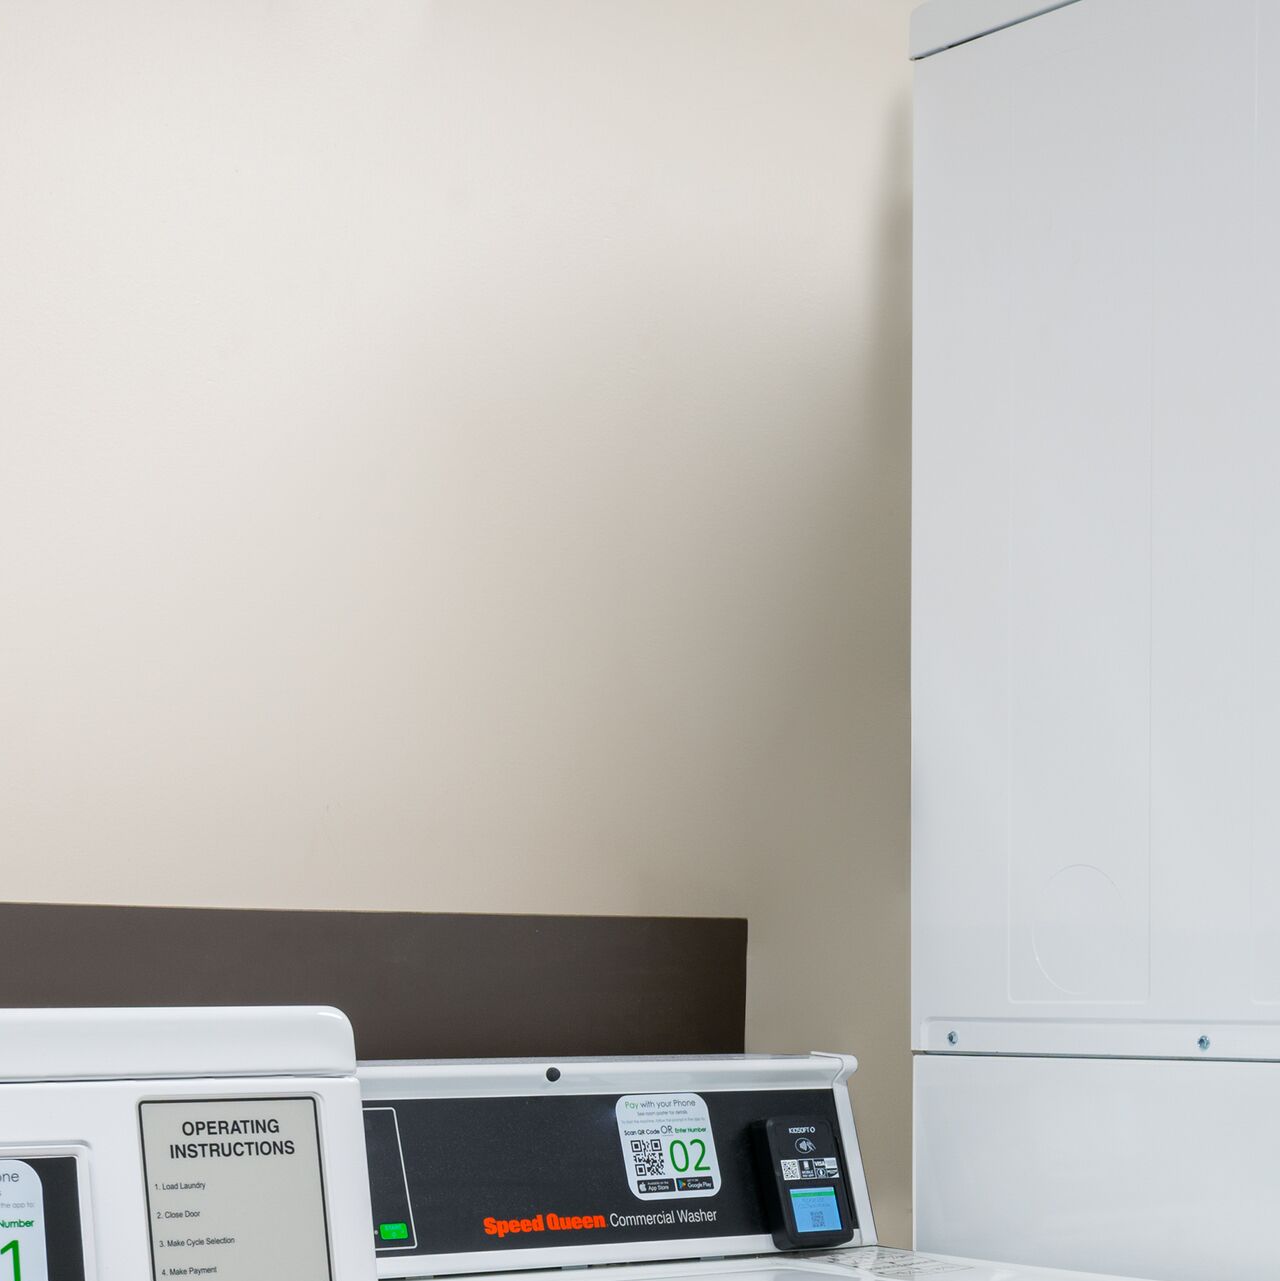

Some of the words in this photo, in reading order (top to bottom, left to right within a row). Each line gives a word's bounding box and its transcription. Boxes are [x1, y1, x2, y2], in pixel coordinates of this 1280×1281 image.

[656, 1101, 671, 1109] your
[673, 1099, 696, 1107] Phone
[182, 1119, 280, 1136] OPERATING
[660, 1125, 673, 1134] OR
[169, 1140, 295, 1159] INSTRUCTIONS
[669, 1138, 711, 1173] 02
[162, 1183, 178, 1191] Load
[180, 1181, 206, 1191] Laundry
[165, 1211, 183, 1219] Close
[185, 1210, 200, 1218] Door
[483, 1214, 544, 1238] Speed
[546, 1212, 606, 1231] Queen
[609, 1210, 675, 1228] Commercial
[676, 1208, 717, 1224] Washer
[167, 1240, 185, 1248] Make
[186, 1238, 205, 1247] Cycle
[206, 1237, 235, 1246] Selection
[169, 1268, 188, 1276] Make
[189, 1266, 217, 1276] Payment
